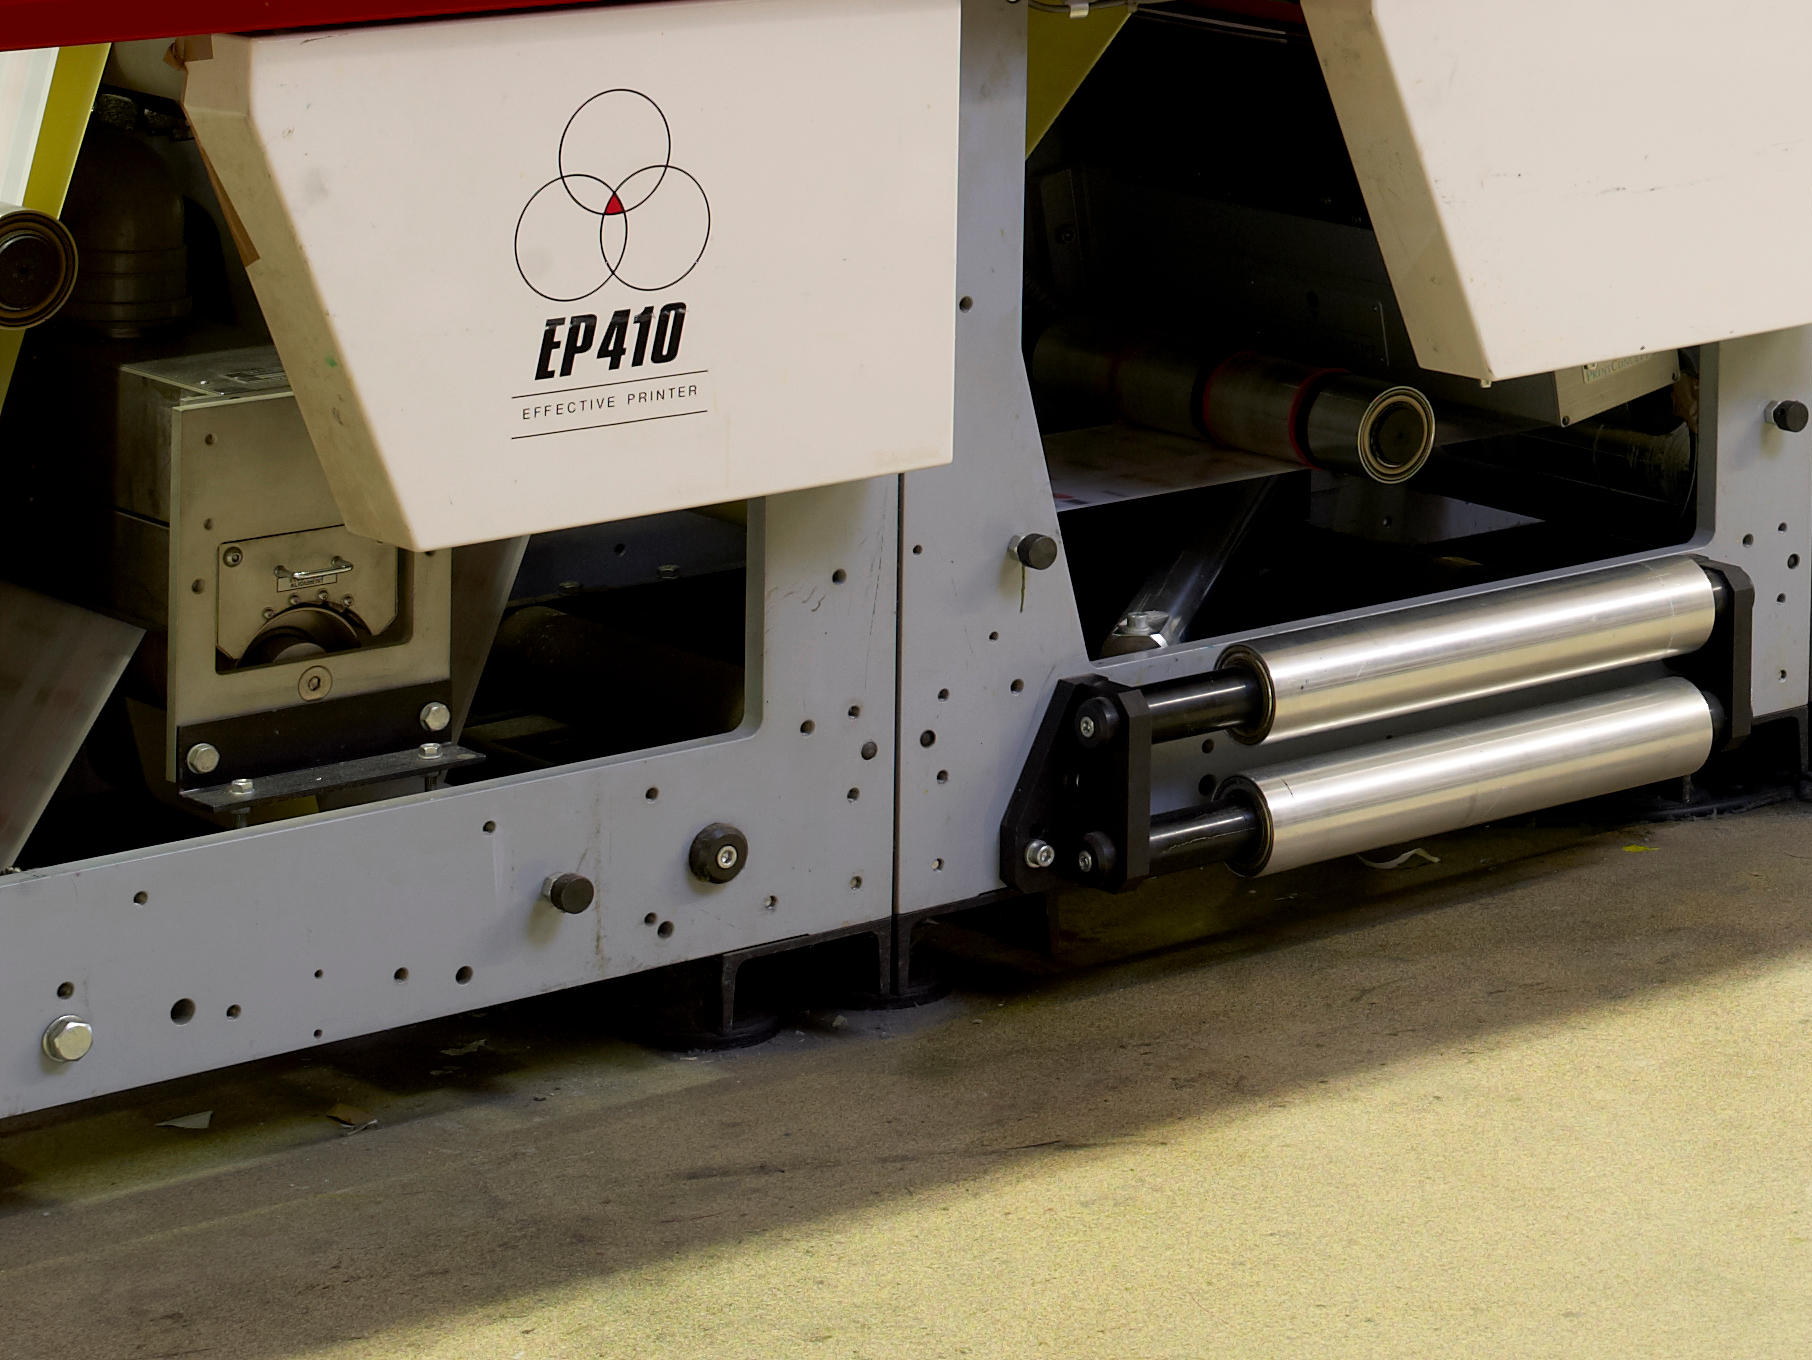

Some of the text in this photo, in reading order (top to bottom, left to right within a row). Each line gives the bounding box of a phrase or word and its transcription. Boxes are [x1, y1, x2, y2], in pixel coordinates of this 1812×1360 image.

[535, 302, 687, 381] EP410
[522, 384, 698, 420] EFFECTIVE PRINTER
